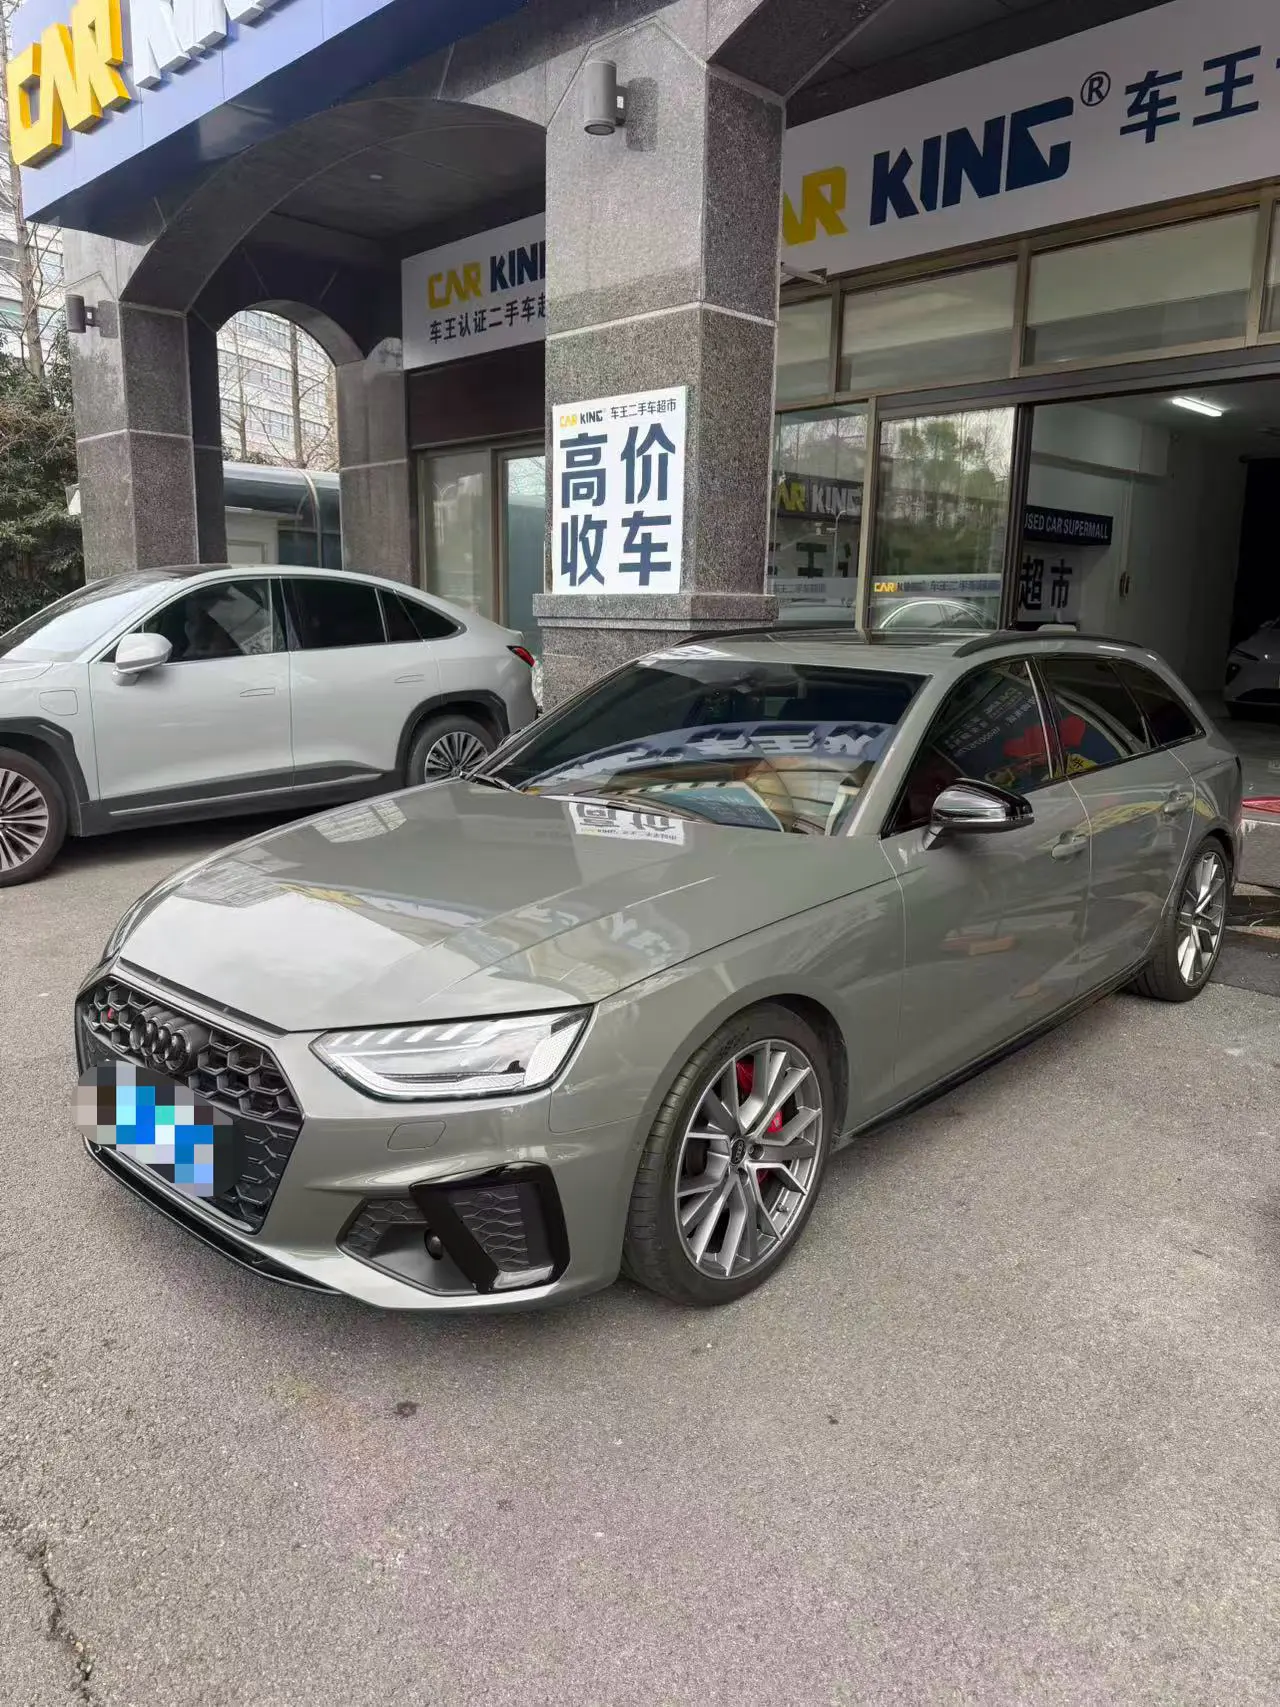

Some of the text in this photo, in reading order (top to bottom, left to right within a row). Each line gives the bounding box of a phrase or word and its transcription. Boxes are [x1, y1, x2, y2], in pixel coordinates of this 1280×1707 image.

[6, 0, 131, 168] CAR
[1119, 45, 1280, 144] 车王
[783, 166, 848, 246] AR
[428, 240, 546, 310] CAR KIN
[560, 409, 604, 428] CAR KING
[611, 398, 676, 420] 车王二手车超市
[559, 422, 676, 509] 高价
[560, 510, 672, 587] 收车
[1045, 515, 1062, 534] CAR
[1063, 518, 1109, 539] SUPERMALL
[874, 582, 896, 593] CAR
[1019, 555, 1073, 610] 超市
